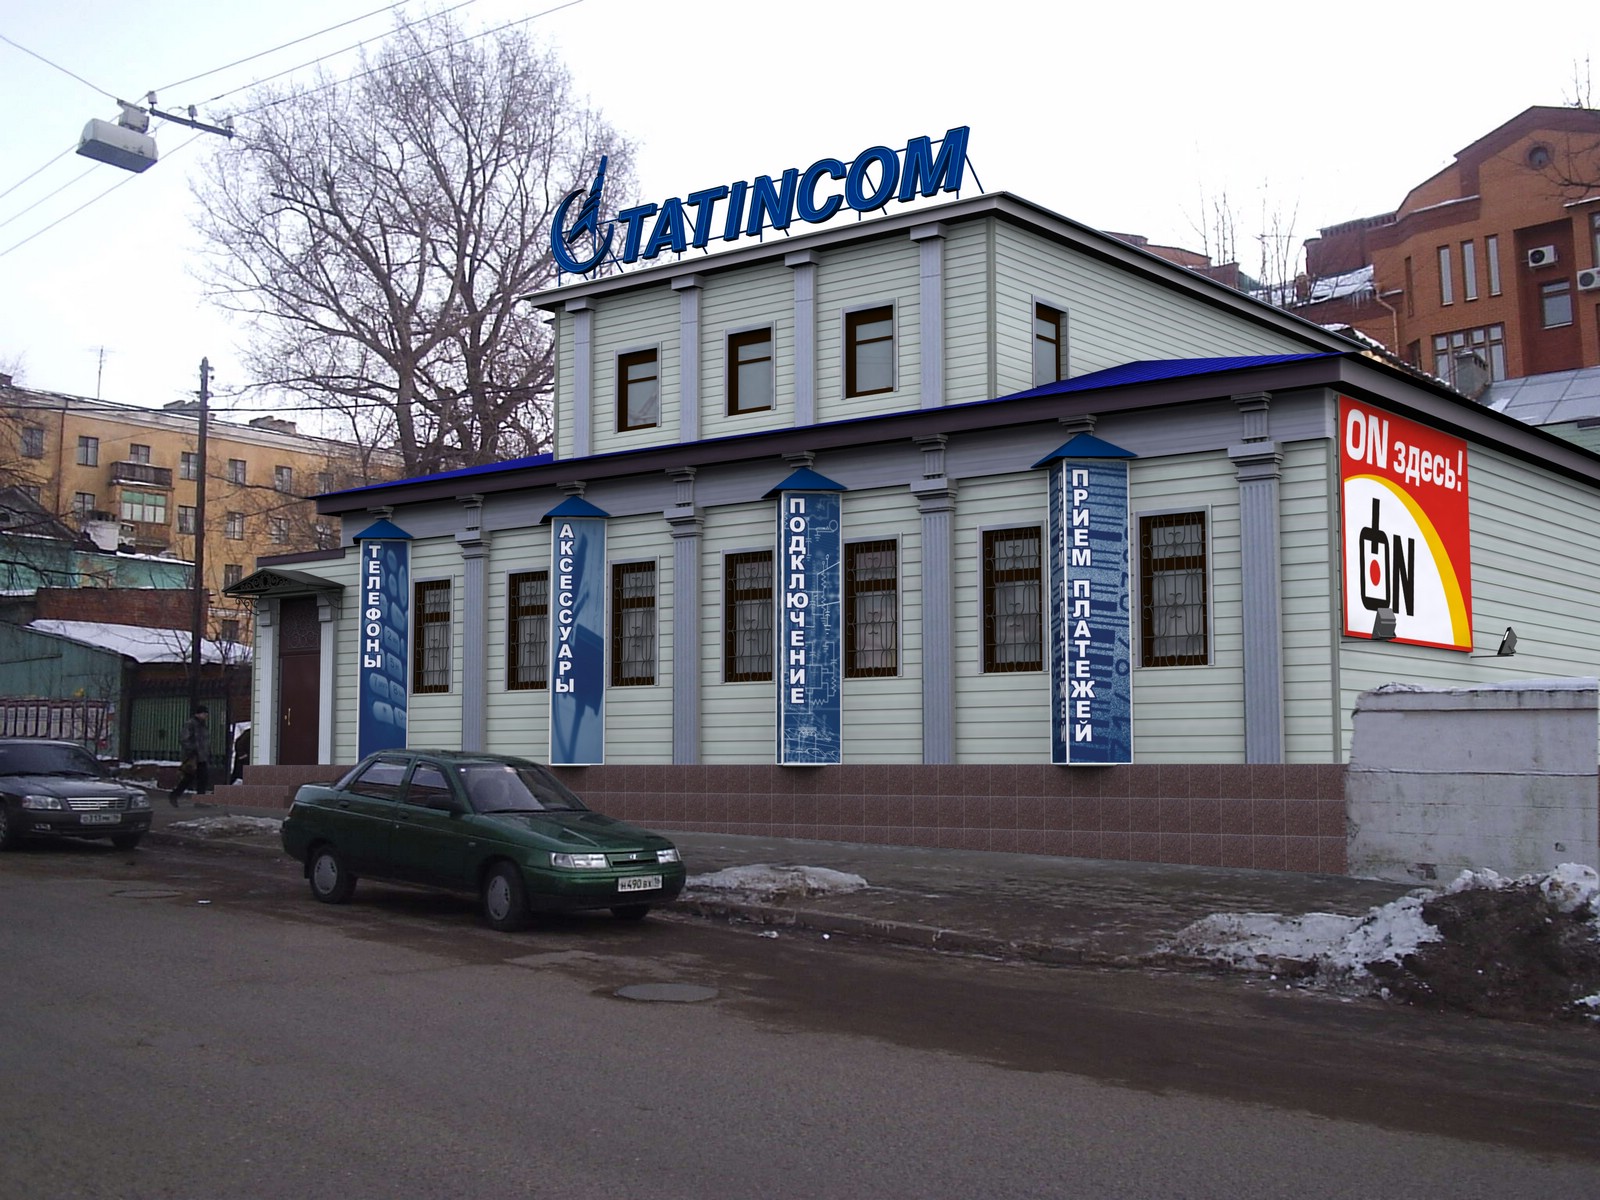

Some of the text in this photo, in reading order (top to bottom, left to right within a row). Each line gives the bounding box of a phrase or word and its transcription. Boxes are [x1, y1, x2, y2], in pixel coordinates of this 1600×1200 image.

[618, 125, 970, 264] TATINCOM
[1345, 409, 1464, 492] ON здесь!
[364, 545, 381, 668] ТЕЛЕФОНЫ
[555, 523, 575, 693] АКСЕССУАРЫ
[786, 498, 809, 704] ПОДКЛЮЧЕНИЕ
[1071, 469, 1096, 742] ПРИЕМ ПЛАТЕЖЕЙ
